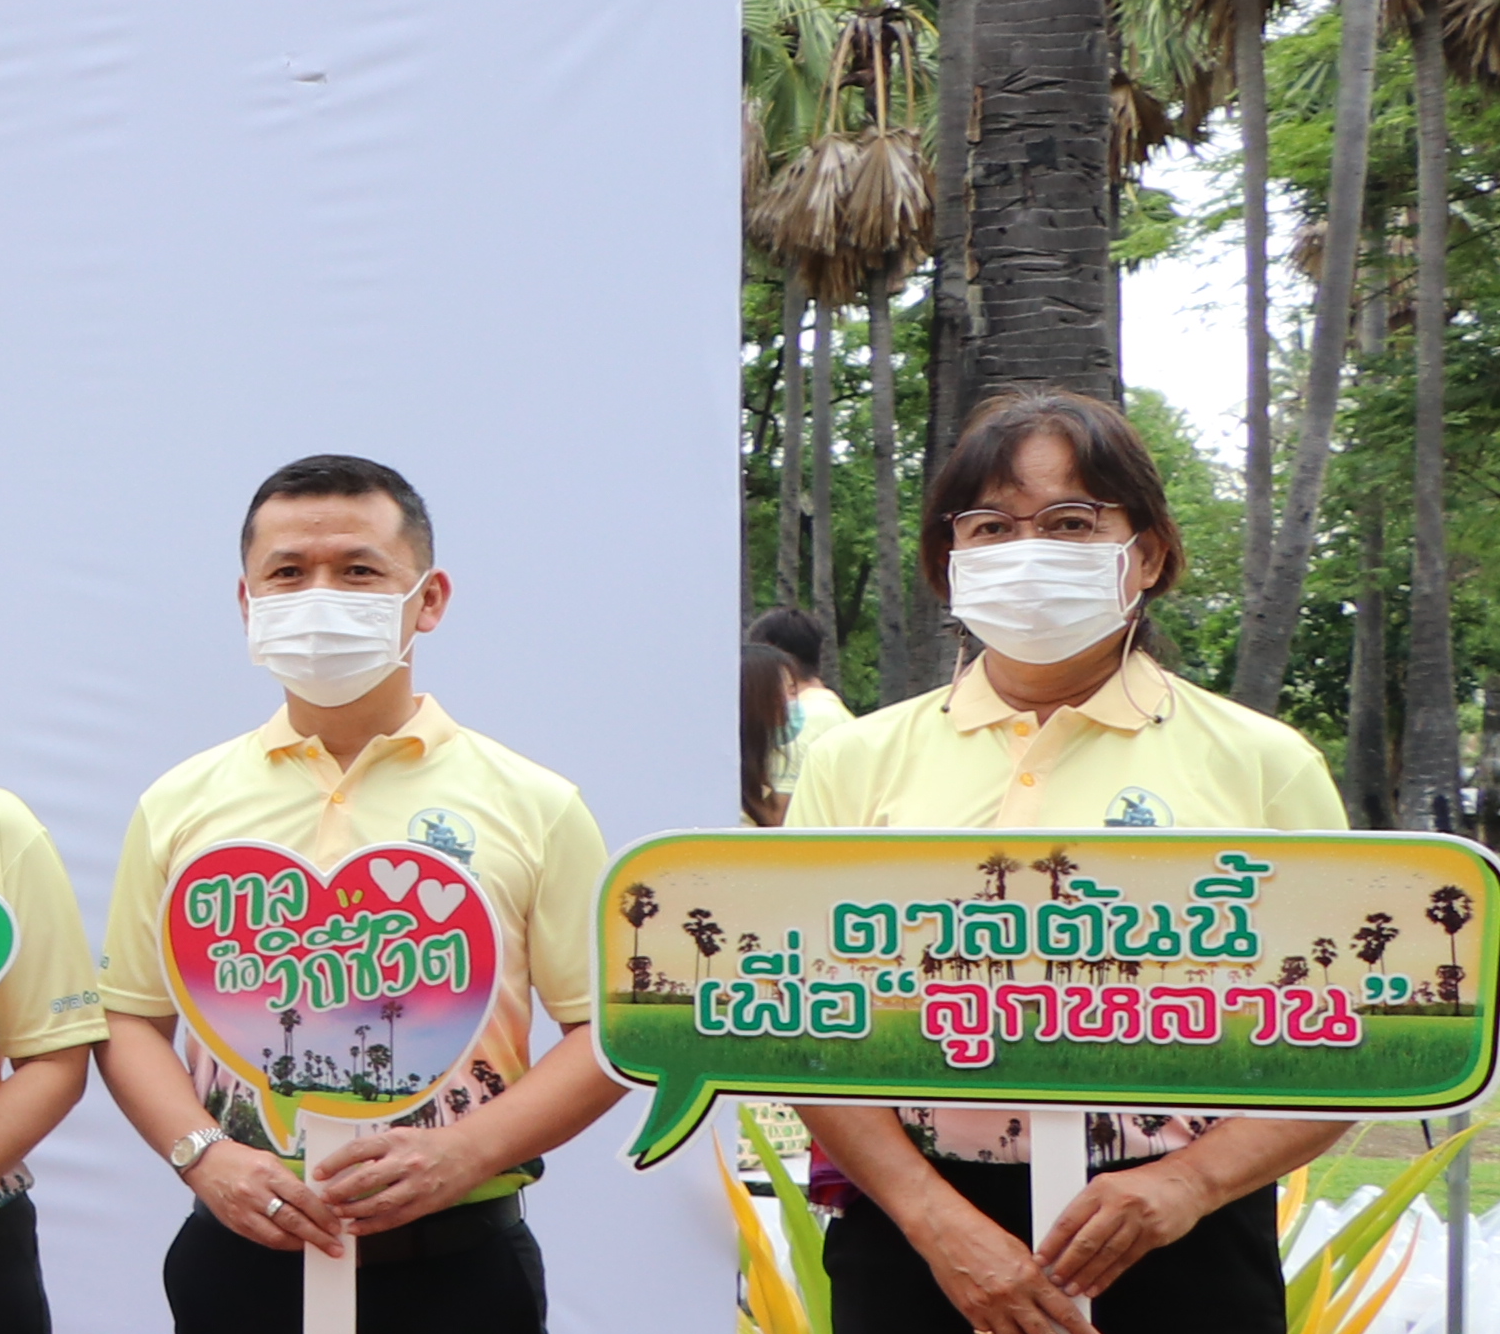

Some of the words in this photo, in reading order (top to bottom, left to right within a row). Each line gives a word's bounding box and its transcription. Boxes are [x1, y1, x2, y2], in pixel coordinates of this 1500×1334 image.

[186, 868, 308, 936] ตาล
[830, 851, 1272, 966] ตาลต้นนี้
